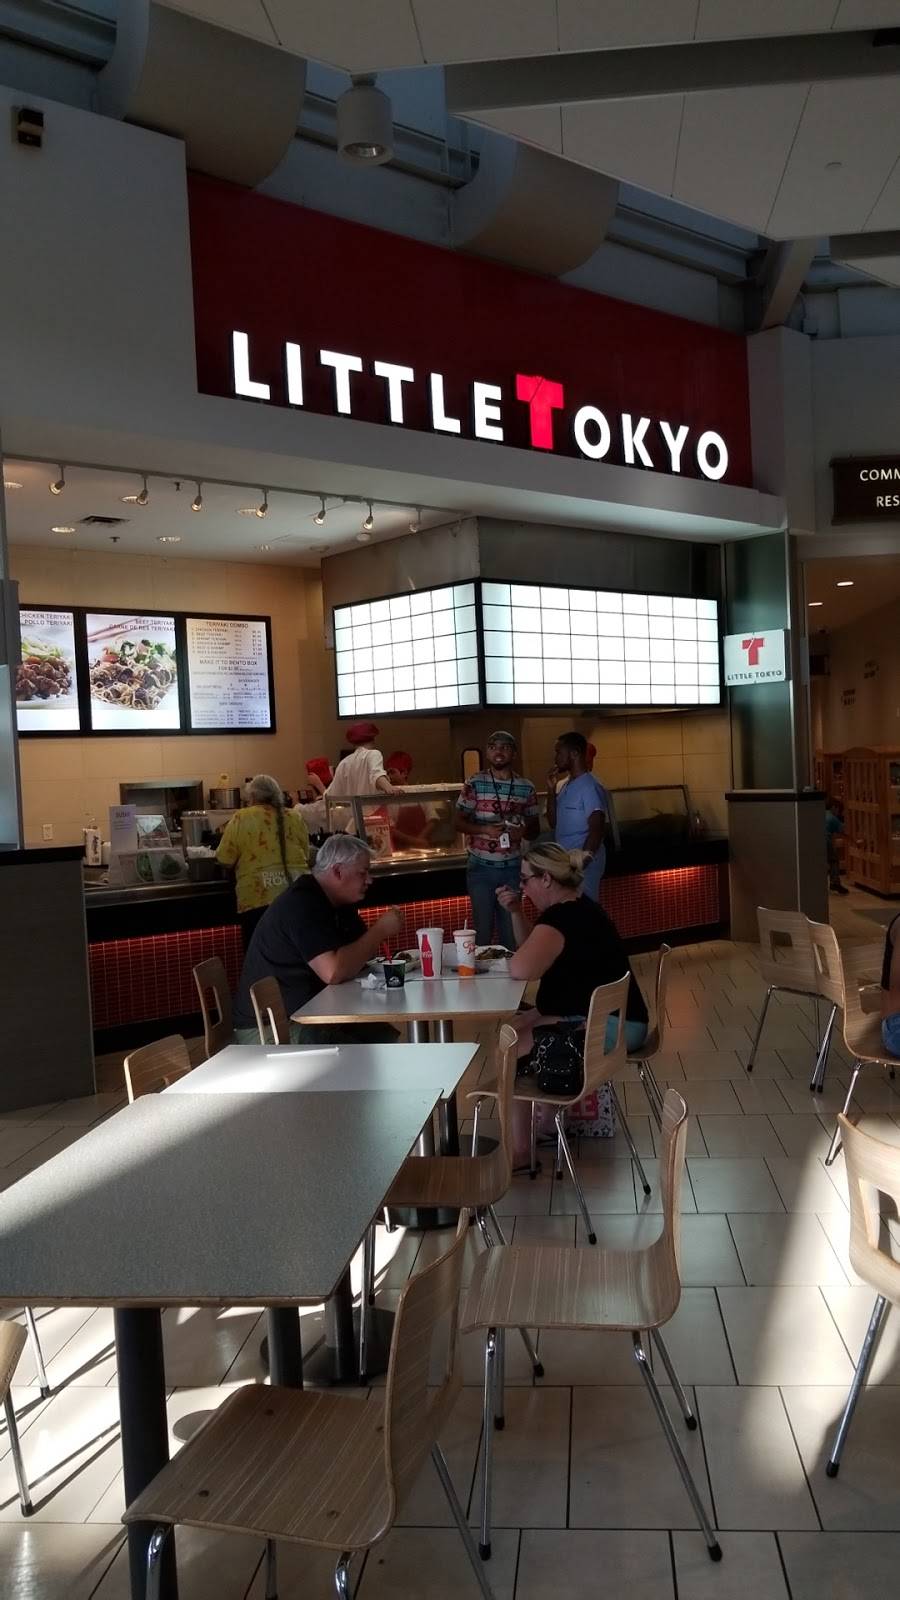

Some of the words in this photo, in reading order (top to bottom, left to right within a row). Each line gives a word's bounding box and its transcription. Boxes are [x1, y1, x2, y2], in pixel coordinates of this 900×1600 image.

[232, 330, 503, 441] LITTLE
[515, 373, 729, 480] TOKYO
[876, 495, 900, 507] RES
[742, 638, 764, 666] T
[727, 672, 752, 681] LITTLE
[755, 670, 782, 678] TOKYO
